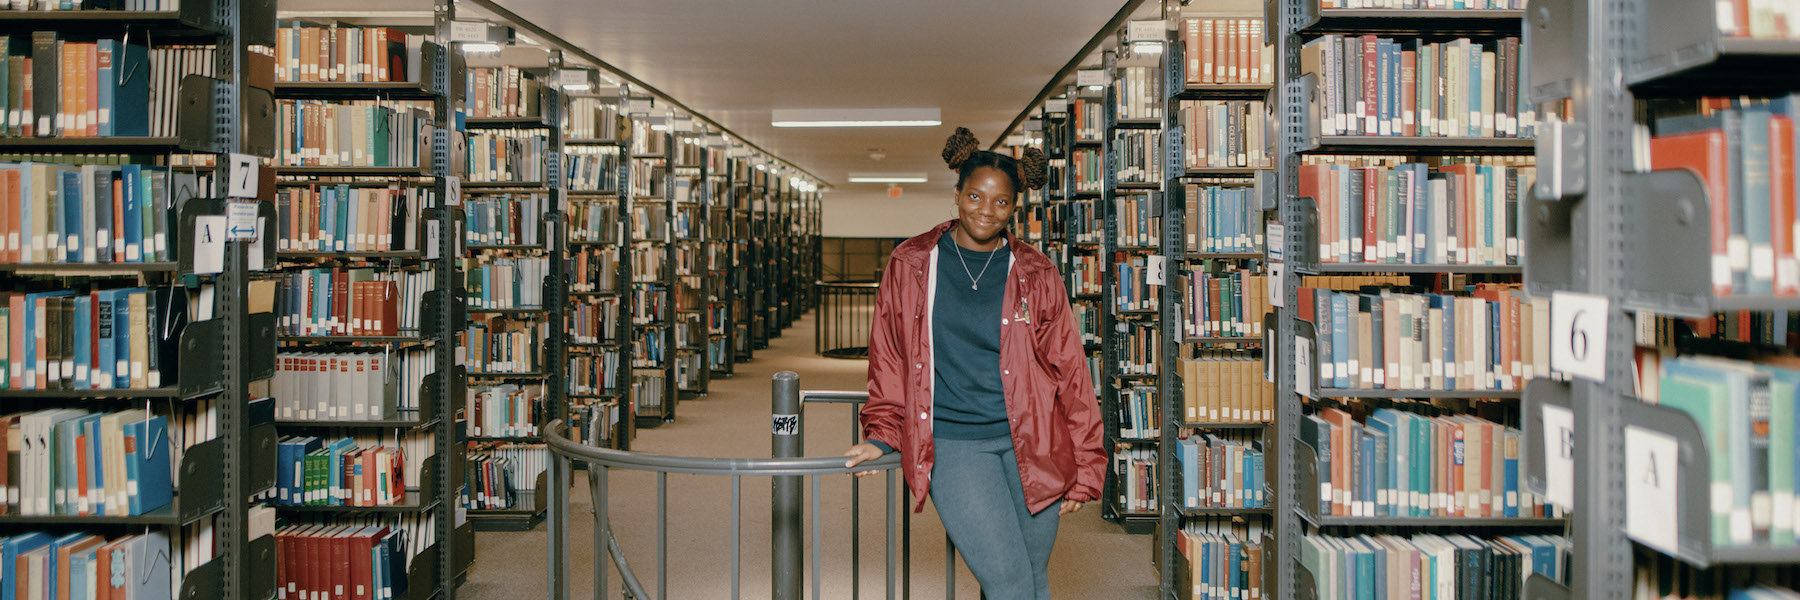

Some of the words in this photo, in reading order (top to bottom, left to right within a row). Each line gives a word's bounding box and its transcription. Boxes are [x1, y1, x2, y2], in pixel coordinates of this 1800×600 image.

[1228, 125, 1236, 156] COLERIDG
[240, 161, 251, 190] 7
[450, 180, 457, 202] 8
[201, 223, 214, 244] A
[430, 225, 436, 239] A
[1271, 270, 1278, 299] 7
[1570, 308, 1587, 362] 6
[1300, 345, 1306, 366] A
[1643, 449, 1661, 489] A
